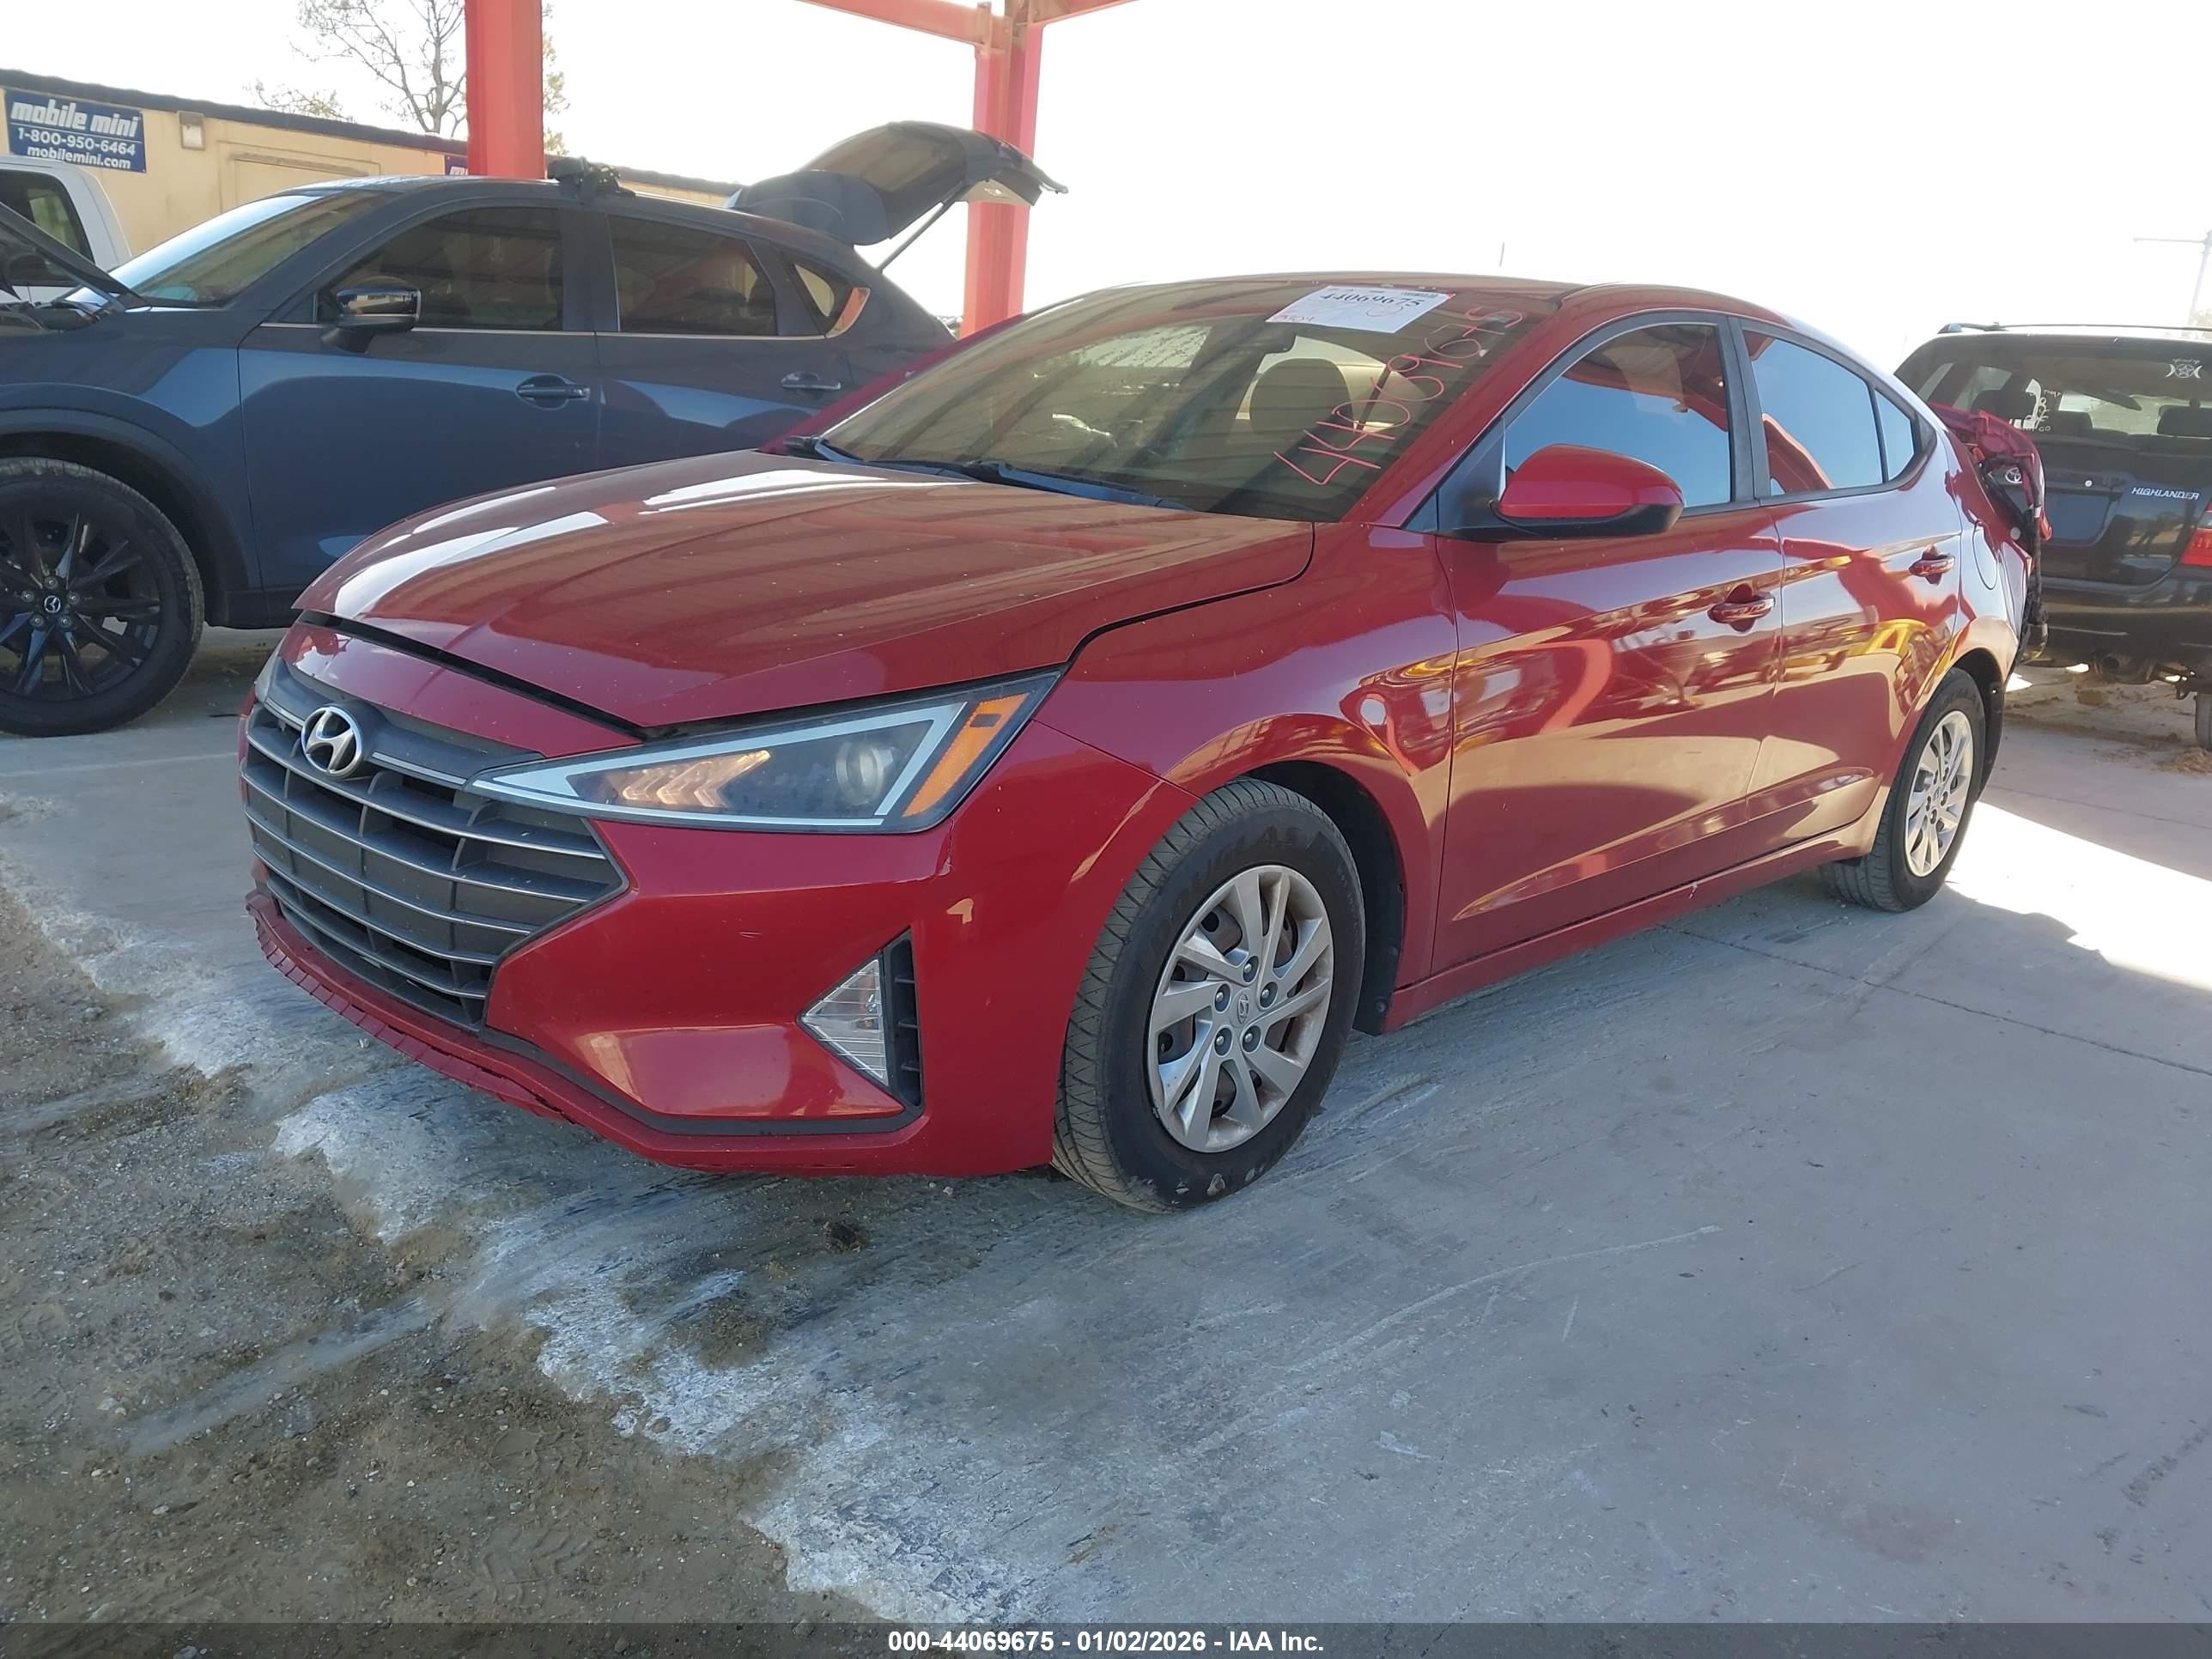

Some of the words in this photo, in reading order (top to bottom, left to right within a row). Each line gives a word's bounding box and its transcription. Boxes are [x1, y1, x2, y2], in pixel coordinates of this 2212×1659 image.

[10, 99, 88, 131] mobile
[90, 112, 139, 137] mini
[17, 127, 136, 156] 1-800-950-6464
[27, 146, 131, 169] mobilemini.com
[2130, 487, 2200, 501] HIGHLANDER
